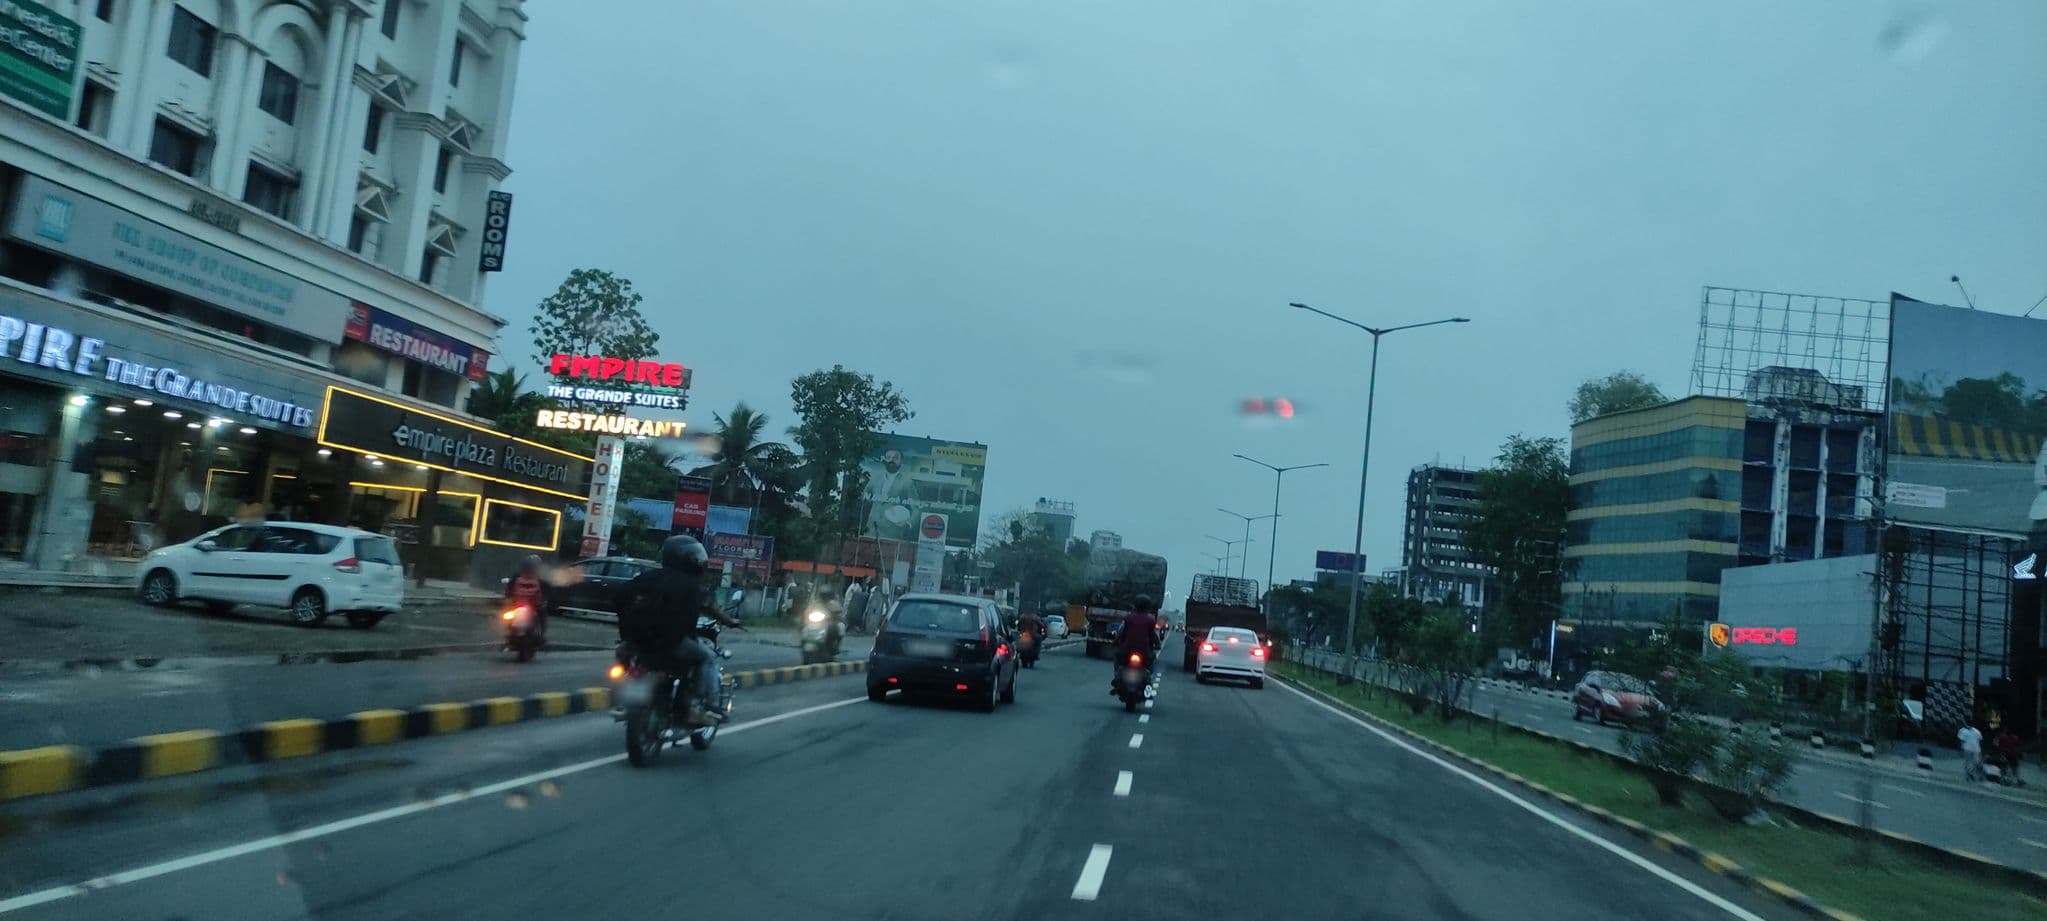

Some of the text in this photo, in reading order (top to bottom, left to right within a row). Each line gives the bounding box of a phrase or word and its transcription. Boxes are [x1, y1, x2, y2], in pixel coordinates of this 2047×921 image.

[483, 201, 506, 268] ROOMS
[370, 324, 468, 374] RESTAURANT
[536, 409, 687, 438] RESTAURANT
[547, 385, 680, 408] THE GRANDE SUITES
[392, 424, 569, 483] empire plaza Restaurant
[588, 443, 612, 536] HOTEL
